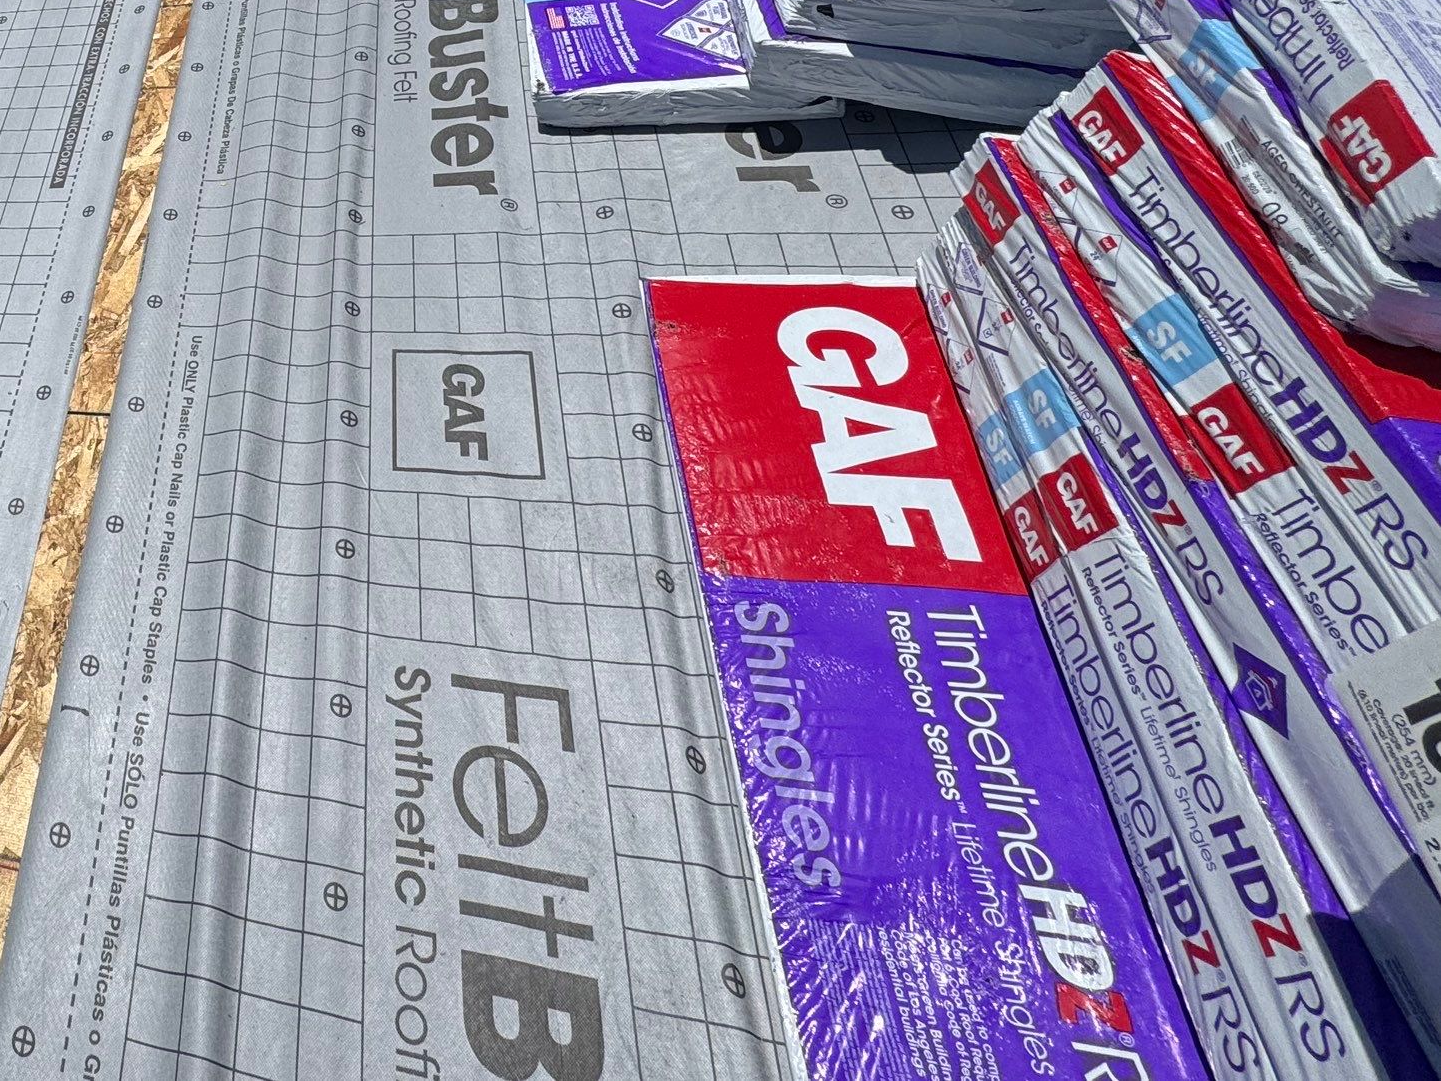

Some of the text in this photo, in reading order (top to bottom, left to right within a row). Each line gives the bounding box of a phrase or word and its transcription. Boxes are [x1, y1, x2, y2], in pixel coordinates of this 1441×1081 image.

[1304, 9, 1356, 71] Reflector
[392, 76, 419, 104] Felt
[53, 116, 82, 186] INCORPORADA
[1261, 139, 1289, 172] AGED
[1332, 115, 1392, 183] GAF
[190, 335, 203, 358] Use
[1078, 109, 1126, 164] GAF
[1356, 492, 1430, 571] RS
[1147, 320, 1192, 365] SF
[183, 359, 200, 394] ONLY
[973, 182, 1005, 233] GAF
[1175, 535, 1224, 606] RS
[1027, 389, 1059, 431] SF
[176, 397, 195, 440] Plastic
[441, 363, 489, 461] GAF
[776, 306, 982, 563] GAF
[1197, 405, 1265, 476] GAF
[170, 443, 188, 471] Cap
[984, 428, 1014, 467] SF
[165, 511, 177, 529] or
[166, 472, 184, 508] Nails
[156, 531, 176, 582] Plastic
[1255, 513, 1306, 590] Reflector
[148, 585, 168, 618] Cap
[140, 621, 163, 686] Staples
[132, 712, 151, 748] Use
[733, 600, 843, 888] Shingles
[1081, 566, 1217, 873] Reflector Shingles
[1392, 712, 1437, 786] (254 mm)
[385, 665, 436, 908] Synthetic
[1014, 505, 1050, 567] GAF
[1200, 986, 1261, 1073] RS
[1056, 471, 1099, 536] GAF
[1275, 970, 1346, 1063] RS
[107, 815, 135, 908] Puntillas
[450, 673, 605, 1081] FeltB
[885, 609, 1055, 1077] Reflector Shingles
[91, 914, 122, 1023] Plásticas
[88, 1029, 102, 1047] o
